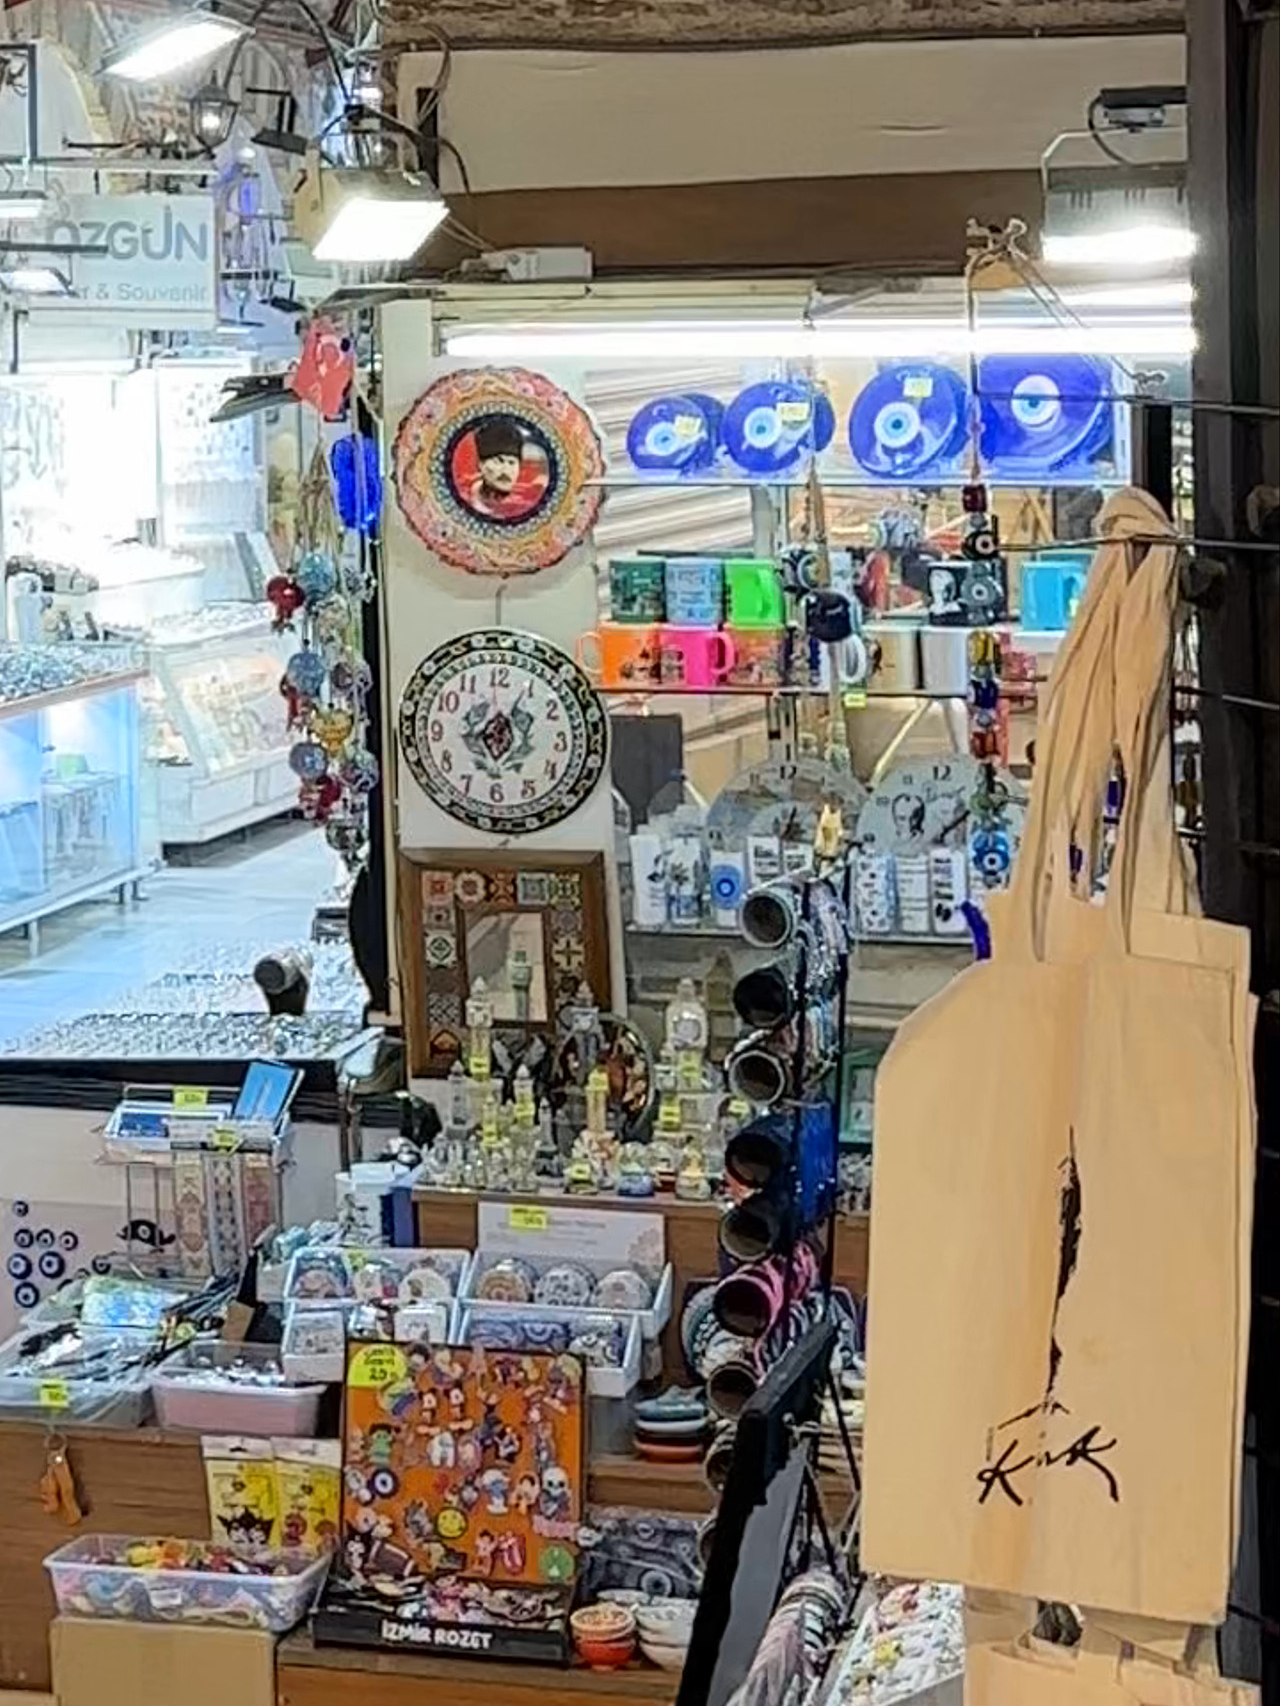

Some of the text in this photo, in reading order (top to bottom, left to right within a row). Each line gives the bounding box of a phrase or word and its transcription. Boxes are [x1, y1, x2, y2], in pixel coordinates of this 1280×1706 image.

[459, 674, 477, 694] 11
[490, 667, 510, 688] 12
[437, 690, 460, 714] 10
[546, 699, 560, 721] 2
[430, 719, 444, 742] 9
[554, 731, 568, 752] 3
[441, 750, 453, 773] 8
[544, 759, 558, 780] 4
[932, 764, 952, 781] 12
[460, 774, 473, 798] 7
[490, 782, 504, 803] 6
[521, 779, 536, 799] 5
[434, 1628, 493, 1650] ROZET
